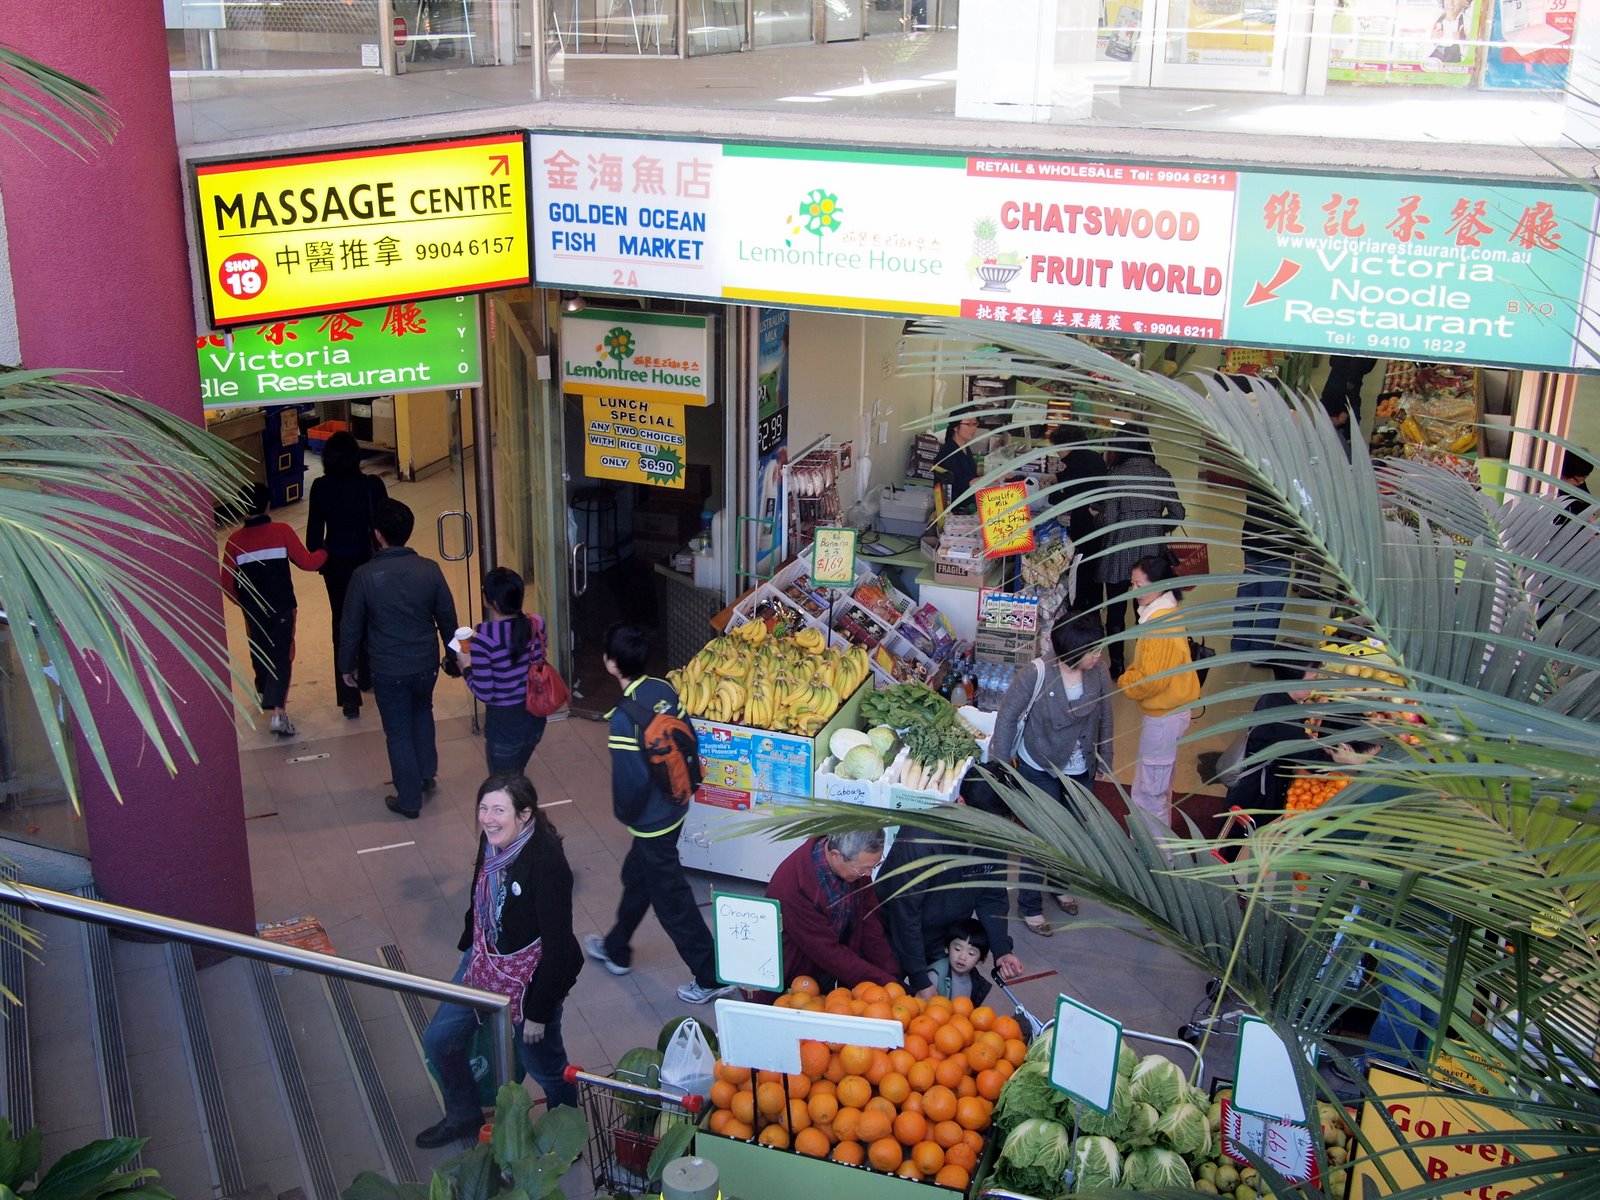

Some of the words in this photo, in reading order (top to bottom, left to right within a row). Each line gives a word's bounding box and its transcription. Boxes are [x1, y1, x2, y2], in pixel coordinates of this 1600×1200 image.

[543, 149, 714, 199] 金海魚店
[976, 161, 1022, 174] RETAIL
[1026, 164, 1036, 175] &
[1038, 164, 1123, 179] WHOLESALE
[1130, 169, 1154, 181] Tel:
[1157, 170, 1190, 182] 9904
[1193, 172, 1226, 184] 6211
[213, 182, 397, 231] MASSAGE
[410, 183, 512, 215] CENTRE
[549, 202, 628, 227] GOLDEN
[639, 207, 706, 233] OCEAN
[1000, 200, 1200, 241] CHATSWOOD
[275, 235, 402, 275] 中醫推拿
[552, 230, 596, 253] FISH
[619, 235, 704, 260] MARKET
[738, 240, 861, 269] Lemontree
[869, 250, 943, 275] House
[1276, 235, 1531, 265] www.victoriarestaurant.com.au
[225, 258, 259, 273] SHOP
[612, 269, 638, 288] 2A
[1030, 254, 1113, 287] FRUIT
[1121, 260, 1223, 296] WORLD
[1316, 249, 1494, 282] Victoria
[227, 273, 262, 295] 19
[1330, 279, 1471, 309] Noodle
[975, 304, 1044, 325] 批發零售
[1051, 309, 1122, 331] 生果蔬菜
[1150, 322, 1181, 336] 9904
[1184, 325, 1214, 338] 6211
[1284, 299, 1514, 338] Restaurant
[1326, 331, 1355, 344] Tel:
[1367, 334, 1410, 349] 9410
[1423, 339, 1466, 353] 1822
[210, 346, 351, 373] Victoria
[565, 361, 648, 382] Lemontree
[652, 369, 701, 387] House
[201, 379, 238, 399] dle
[257, 362, 430, 394] Restaurant
[600, 398, 648, 412] LUNCH
[611, 410, 674, 427] SPECIAL
[590, 435, 614, 446] WITH
[620, 441, 642, 450] RICE
[645, 445, 657, 454] (L)
[591, 422, 611, 431] ANY
[615, 426, 636, 435] TWO
[640, 430, 683, 444] CHOICES
[602, 457, 627, 467] ONLY
[640, 459, 673, 473] $6.90
[938, 564, 966, 576] FRAGILE
[720, 904, 767, 924] Orange
[1267, 1128, 1291, 1169] 1.99
